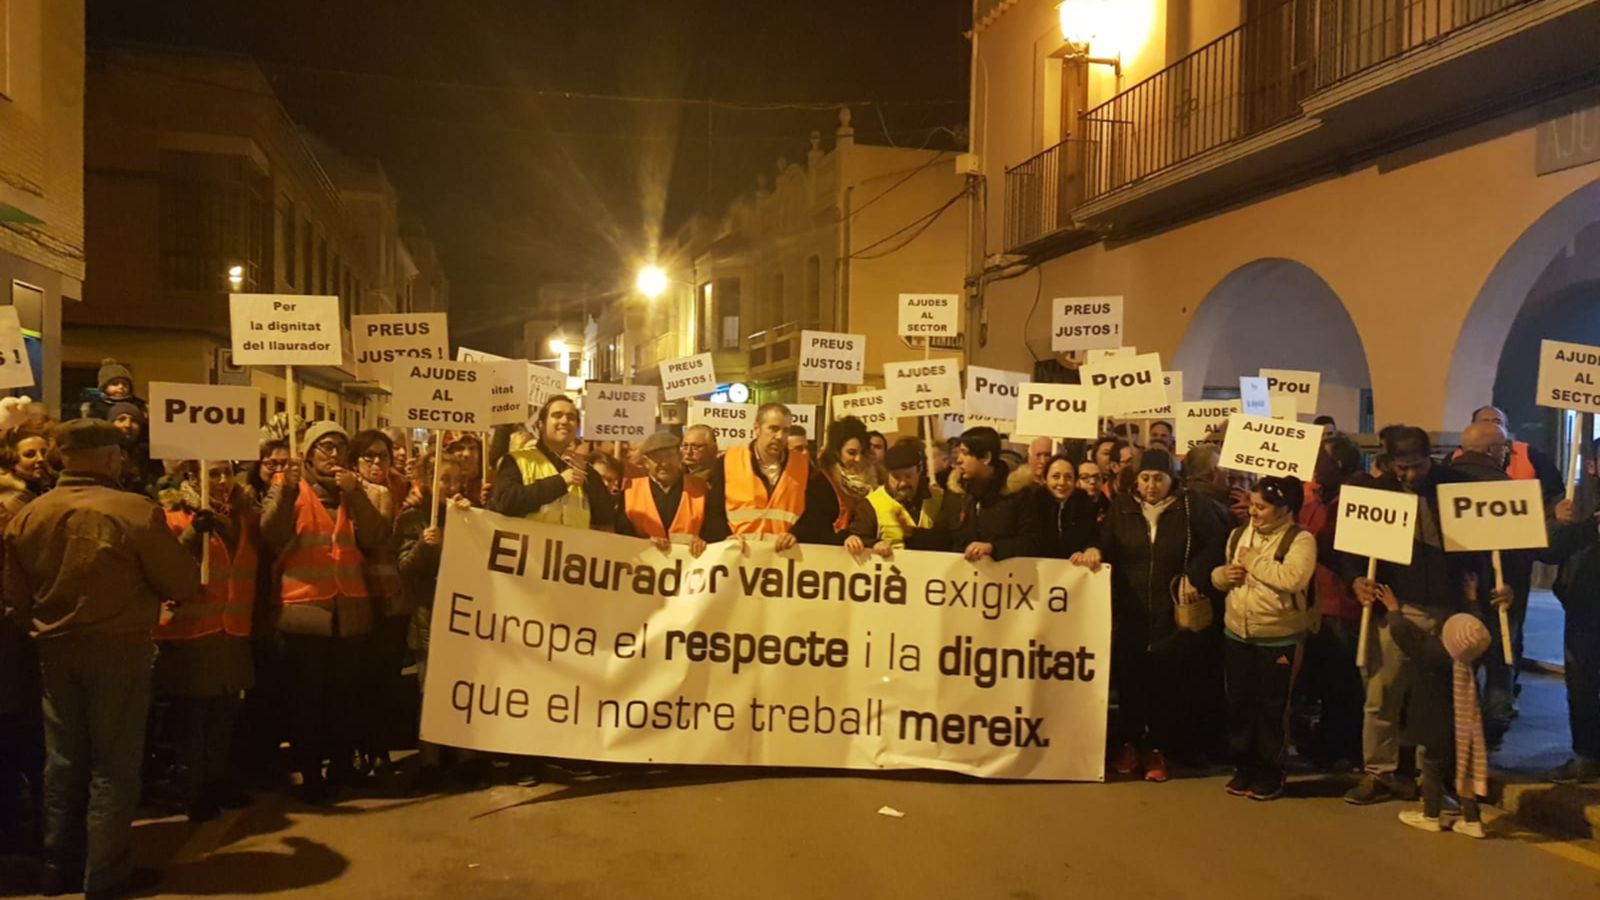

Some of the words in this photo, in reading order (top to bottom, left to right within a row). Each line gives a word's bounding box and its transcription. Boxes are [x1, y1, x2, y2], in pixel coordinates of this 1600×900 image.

[273, 302, 296, 311] Per
[907, 299, 948, 307] AJUDES
[1064, 303, 1111, 315] PREUS
[921, 311, 934, 319] AL
[250, 321, 263, 331] la
[268, 321, 321, 333] dignitat
[367, 322, 430, 337] PREUS
[907, 324, 948, 332] SECTOR
[1055, 324, 1111, 337] JUSTOS
[243, 341, 264, 351] del
[269, 341, 330, 351] llaurador
[811, 338, 854, 351] PREUS
[802, 358, 853, 370] JUSTOS
[1555, 349, 1600, 366] AJUD
[668, 359, 704, 373] PREUS
[897, 365, 946, 379] AJUDES
[410, 366, 477, 382] AJUDES
[1574, 372, 1594, 385] AL
[665, 376, 707, 390] JUSTOS
[916, 383, 932, 393] AL
[975, 376, 1019, 398] Prou
[1266, 377, 1311, 394] Prou
[432, 389, 453, 401] AL
[599, 390, 647, 402] AJUDES
[843, 395, 885, 409] PREUS
[900, 397, 951, 411] SECTOR
[1027, 393, 1087, 413] Prou
[164, 398, 245, 425] Prou
[408, 409, 475, 424] SECTOR
[613, 407, 629, 418] AL
[703, 407, 747, 419] PREUS
[595, 424, 645, 435] SECTOR
[1242, 421, 1306, 440] AJUDES
[1259, 441, 1279, 453] AL
[1234, 453, 1299, 473] SECTOR
[1345, 502, 1398, 526] PROU
[1453, 497, 1528, 520] Prou
[487, 529, 529, 577] El
[541, 538, 729, 598] llaurador
[739, 558, 907, 605] valencià
[925, 571, 1035, 620] exigix
[1047, 585, 1069, 613] a
[448, 592, 597, 662] Europa
[614, 623, 648, 659] el
[664, 630, 849, 675] respecte
[865, 631, 872, 669] i
[889, 632, 921, 672] la
[938, 636, 1095, 689] dignitat
[451, 678, 530, 725] que
[546, 685, 580, 726] el
[596, 696, 735, 732] nostre
[750, 695, 882, 738] treball
[899, 706, 1050, 748] mereix.
